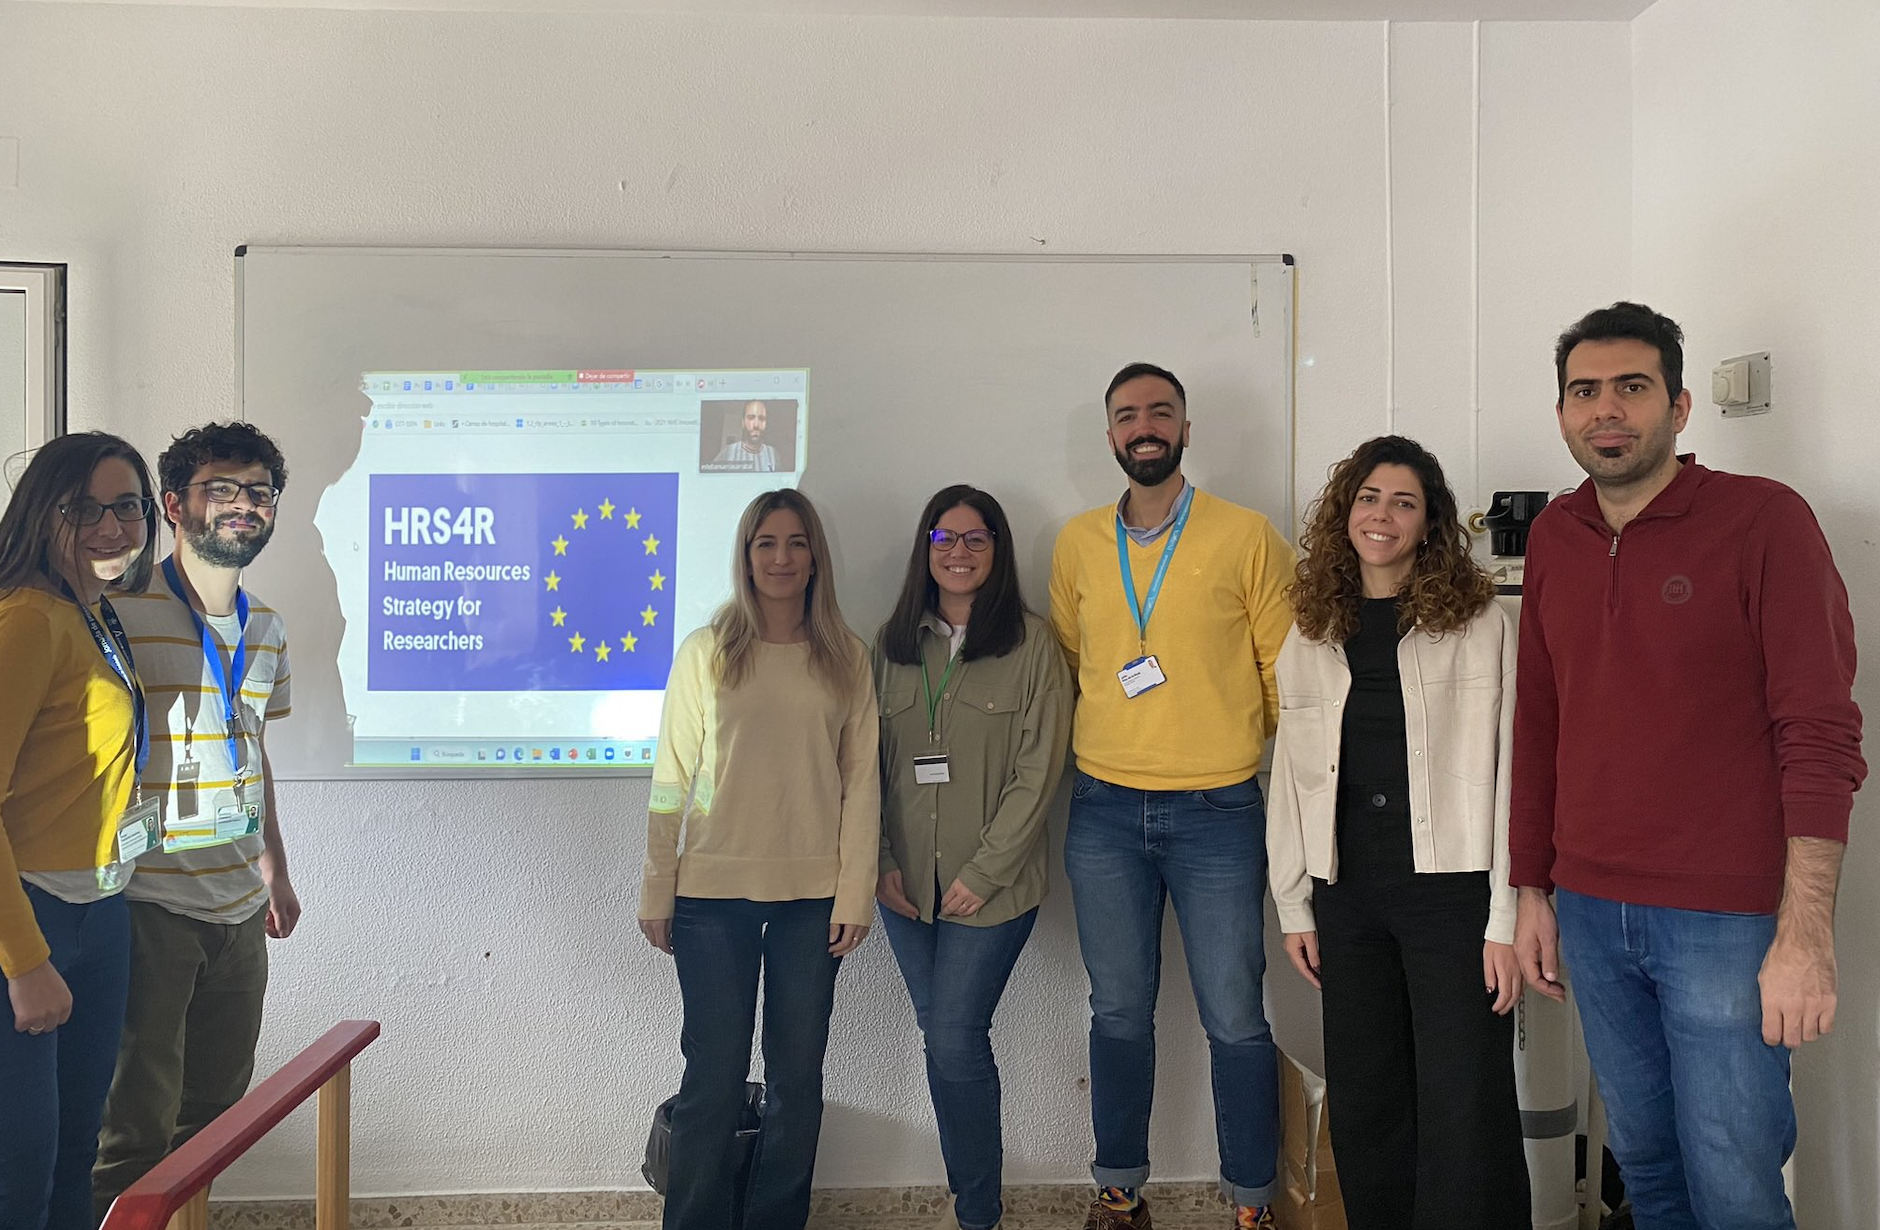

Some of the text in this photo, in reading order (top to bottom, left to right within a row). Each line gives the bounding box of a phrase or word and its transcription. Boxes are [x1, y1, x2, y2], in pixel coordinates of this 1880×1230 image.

[585, 372, 598, 381] Dejar
[607, 372, 630, 382] compartir
[383, 506, 496, 546] HRS4R
[384, 561, 531, 582] Human Resources
[383, 595, 482, 620] Strategy for
[383, 630, 484, 651] Researchers
